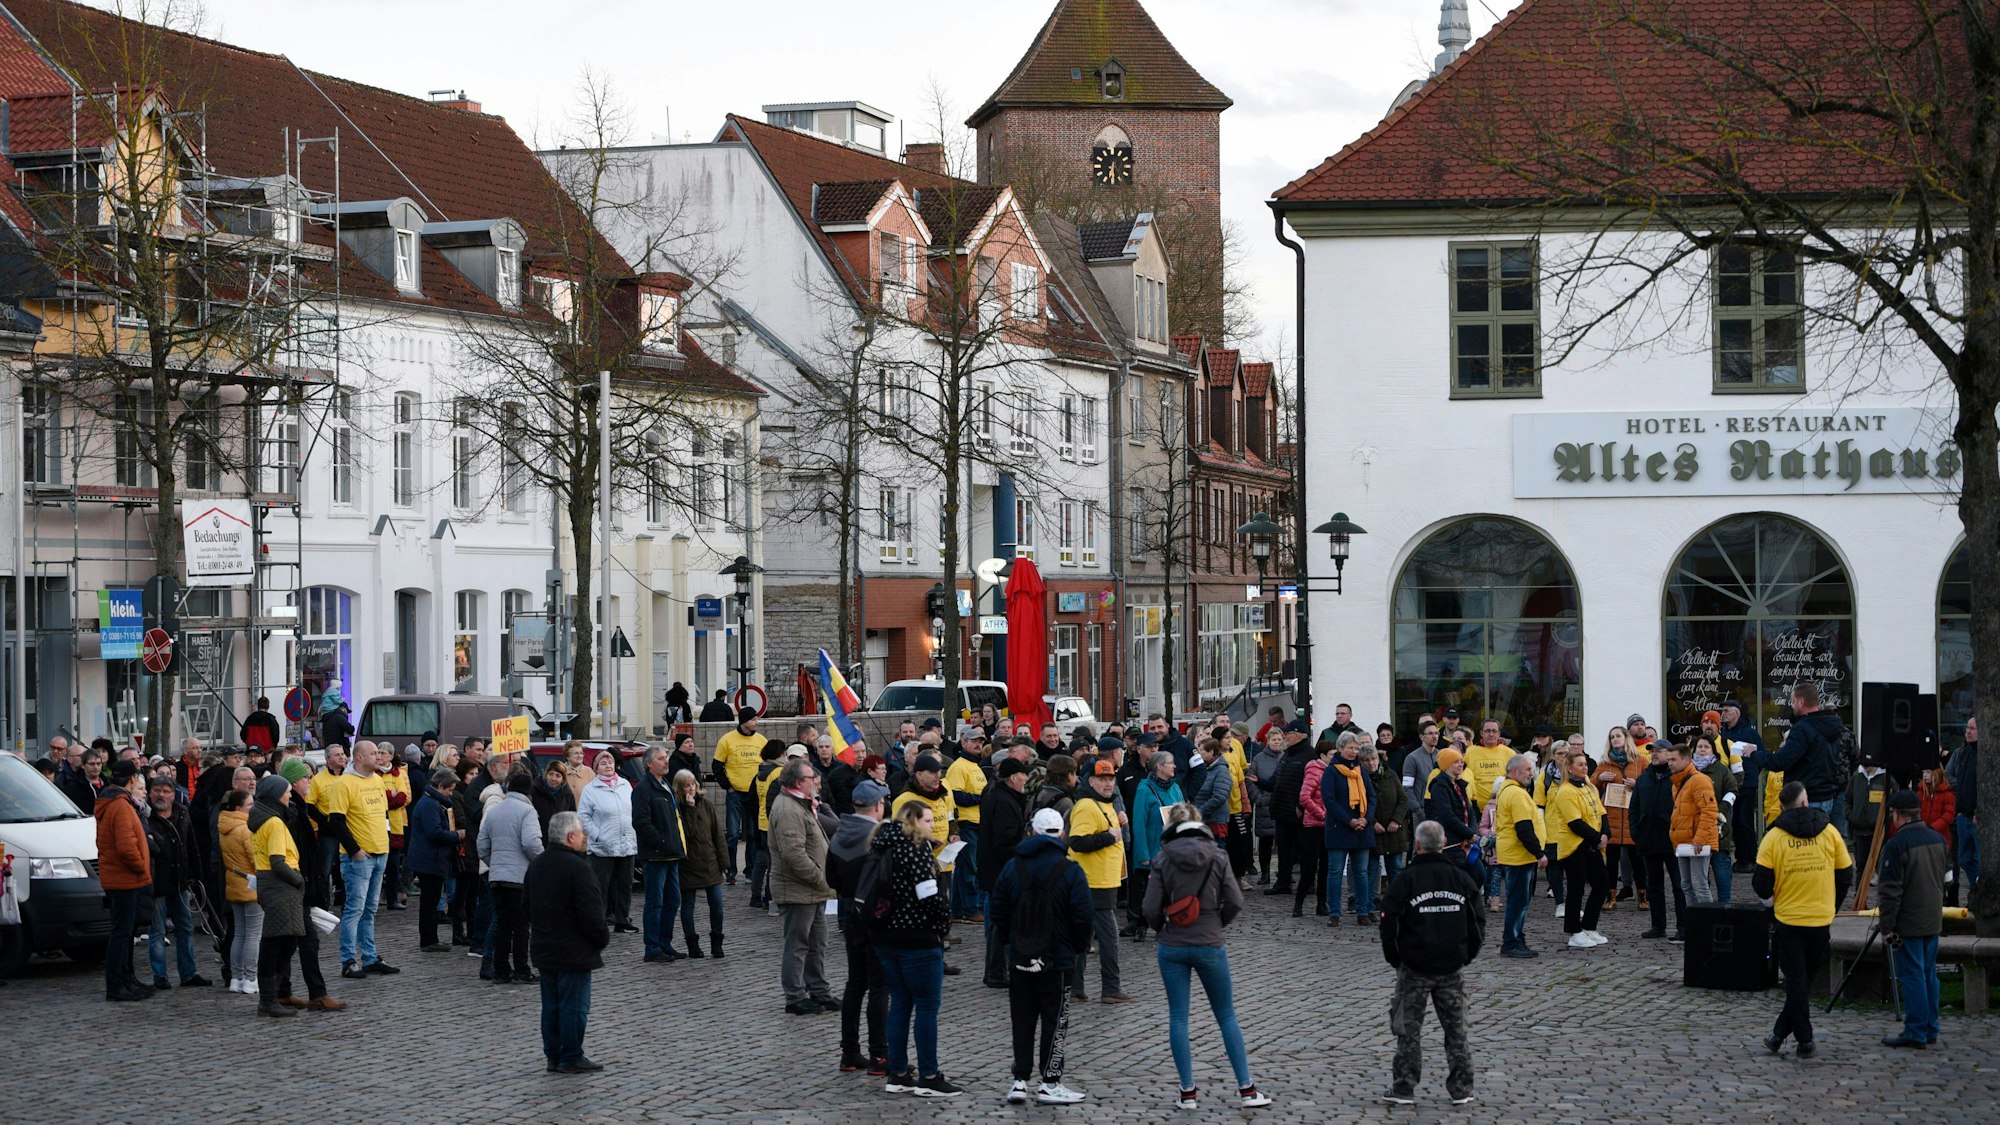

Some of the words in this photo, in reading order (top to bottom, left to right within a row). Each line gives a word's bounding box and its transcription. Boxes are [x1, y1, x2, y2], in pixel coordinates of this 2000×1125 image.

[1625, 418, 1705, 434] HOTEL
[1725, 414, 1887, 434] RESTAURANT
[1553, 441, 1699, 484] Altes
[1729, 437, 1962, 491] Rathaus
[110, 599, 136, 618] klein
[192, 636, 213, 646] HABEN
[1768, 628, 1831, 652] Vielleicht
[1675, 646, 1735, 668] Vielleicht
[1479, 761, 1501, 770] Upahl
[1788, 836, 1819, 850] Upahl
[1410, 891, 1434, 907] MARIO
[1418, 904, 1461, 913] BAUBETRIEB
